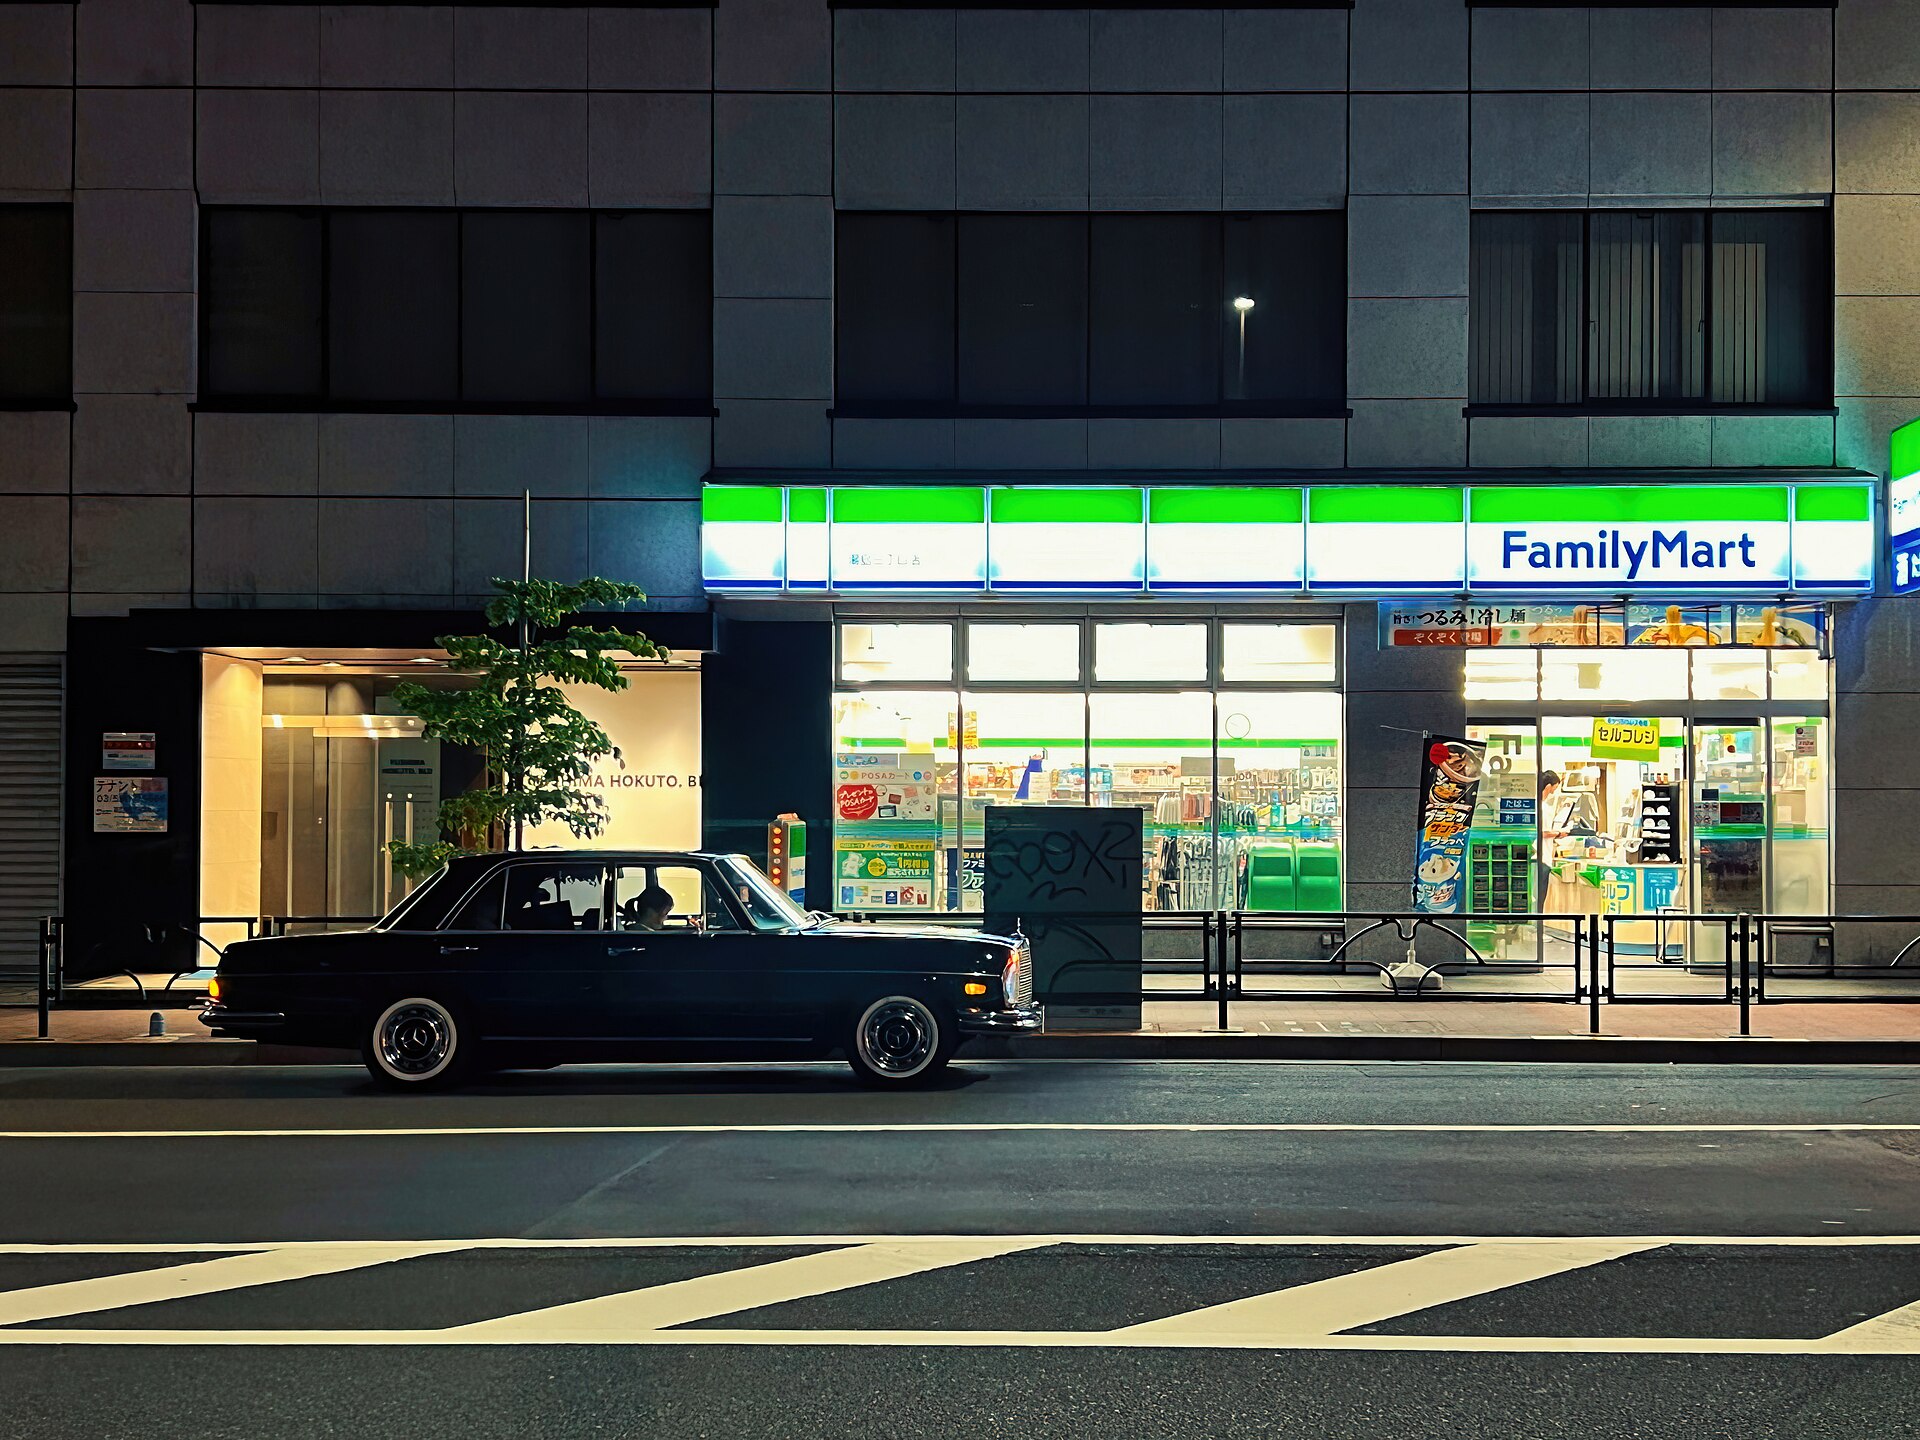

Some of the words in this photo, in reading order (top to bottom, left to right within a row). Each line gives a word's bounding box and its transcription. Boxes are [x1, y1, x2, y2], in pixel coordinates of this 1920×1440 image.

[1502, 529, 1756, 580] FamilyMart
[610, 774, 683, 788] HOKUTO.
[1505, 799, 1531, 808] たばこ
